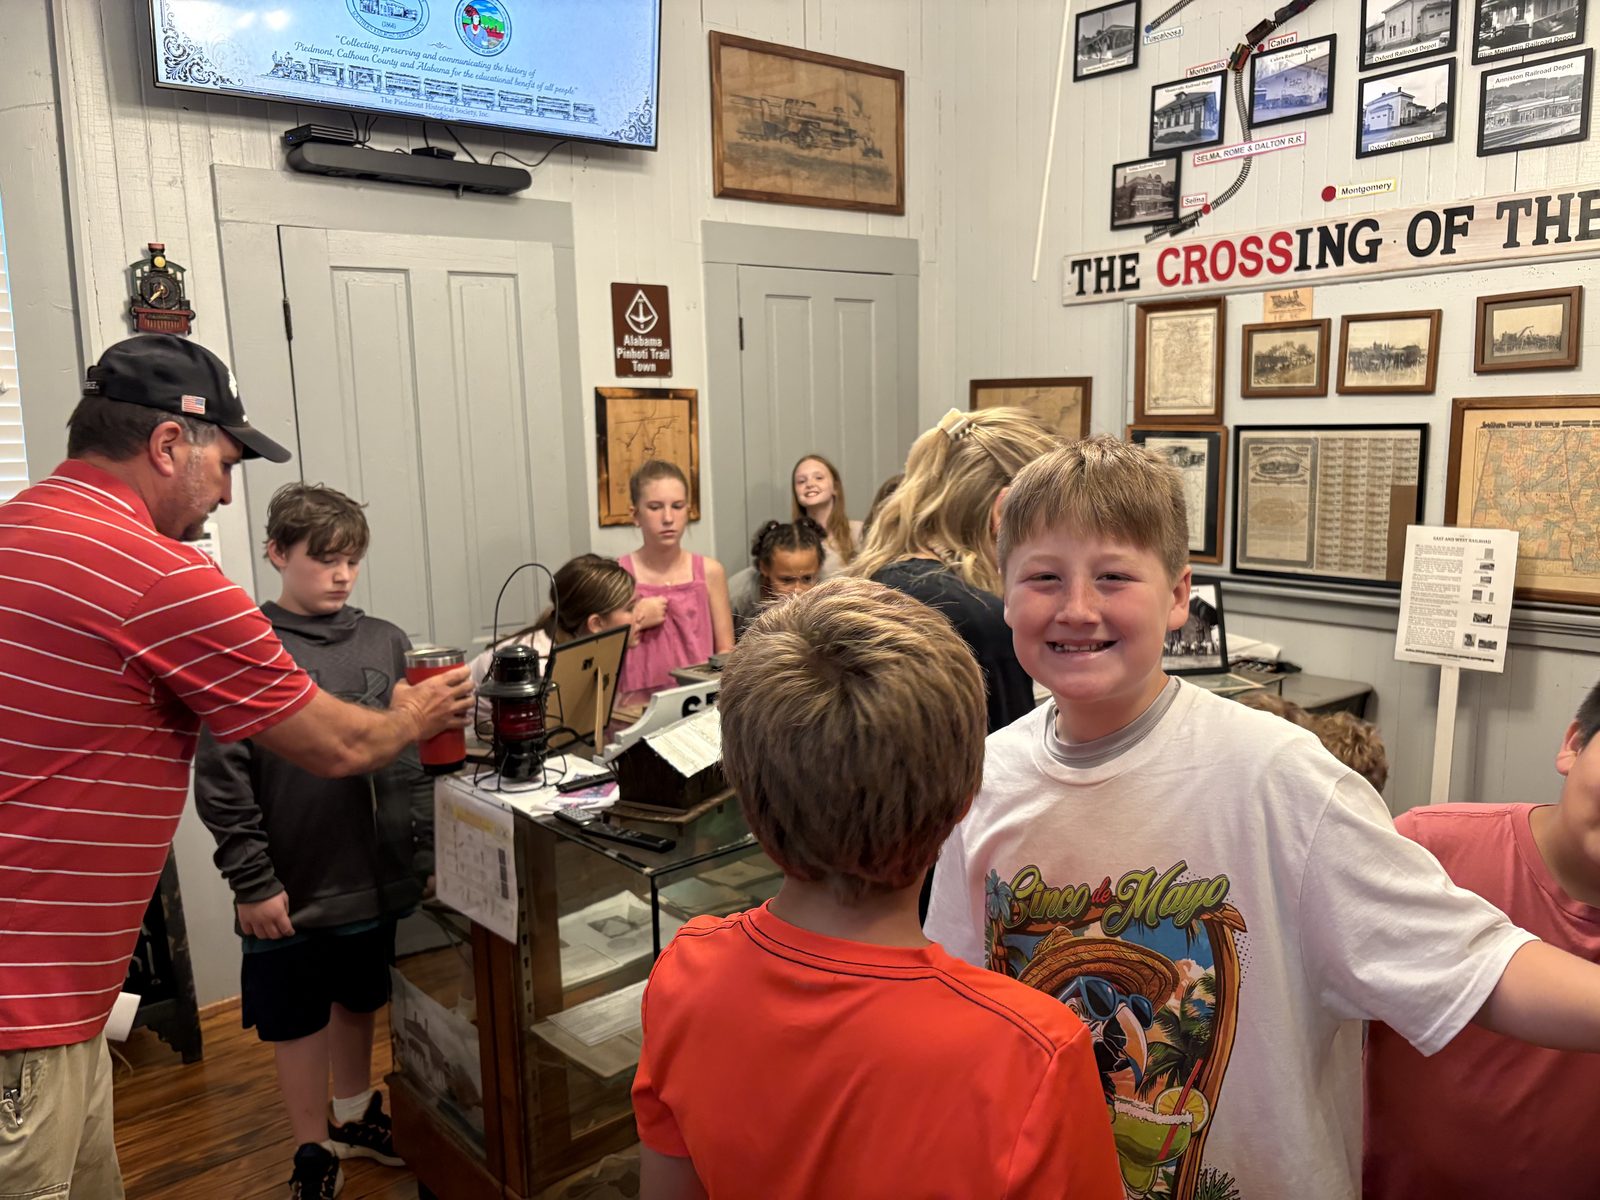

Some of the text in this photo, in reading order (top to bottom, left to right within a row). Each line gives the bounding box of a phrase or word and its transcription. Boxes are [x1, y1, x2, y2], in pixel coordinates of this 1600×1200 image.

[1145, 28, 1182, 44] Tuscaloosa
[1270, 36, 1294, 48] Calera
[1494, 45, 1524, 56] Mountain
[1525, 38, 1552, 50] Railroad
[1553, 33, 1574, 44] Depot
[1375, 42, 1436, 62] Oxford Railroad Depot
[294, 41, 335, 57] Piedmont,
[336, 48, 369, 61] Calhoun
[372, 54, 398, 69] County
[400, 60, 414, 69] and
[416, 62, 450, 75] Alabama
[450, 68, 462, 78] for
[463, 69, 474, 79] the
[475, 72, 513, 85] educational
[514, 78, 535, 90] benefit
[536, 82, 544, 92] of
[545, 83, 554, 91] all
[382, 45, 420, 60] preserving
[423, 51, 437, 60] and
[438, 55, 492, 72] communicating
[493, 63, 503, 72] the
[504, 64, 527, 78] history
[528, 69, 536, 78] of
[1189, 62, 1226, 76] Montevallo
[1495, 63, 1573, 84] Anniston Railroad Depot
[394, 98, 424, 109] Piedmont
[425, 101, 454, 112] Historical
[455, 107, 477, 117] Society,
[1196, 151, 1222, 162] SELMA,
[1224, 147, 1245, 157] ROME
[1255, 138, 1285, 150] DALTON
[1287, 135, 1304, 146] R.R.
[1370, 133, 1431, 151] Oxford Railroad Depot
[1341, 182, 1392, 196] Montgomery
[1185, 196, 1205, 205] Selma
[1071, 189, 1600, 296] THE CROSSING OF THE
[624, 335, 662, 347] Alabama
[616, 348, 670, 360] Pinhoti Trail
[632, 361, 656, 372] Town
[1004, 860, 1230, 936] Cinco de Mayo
